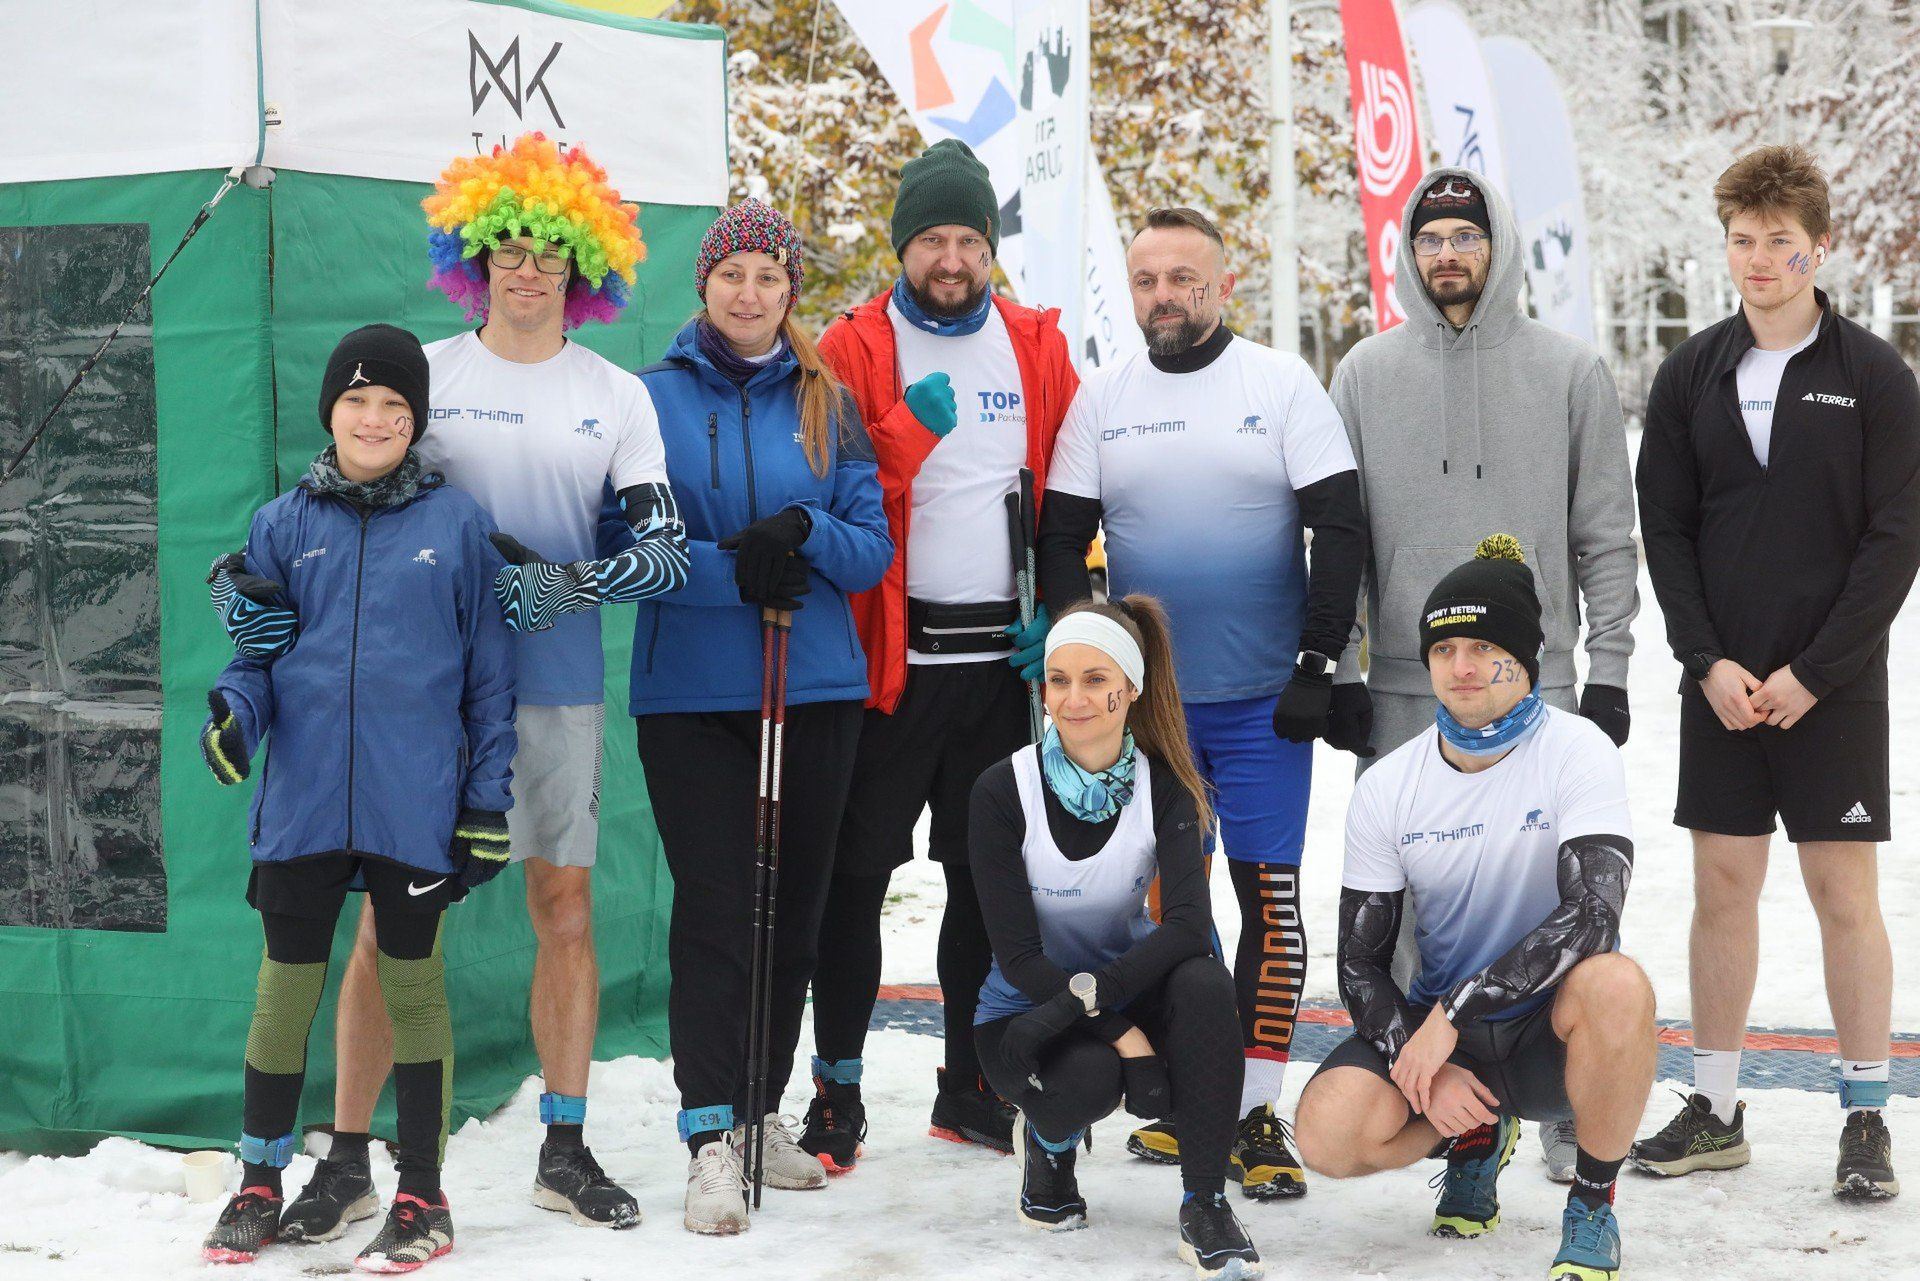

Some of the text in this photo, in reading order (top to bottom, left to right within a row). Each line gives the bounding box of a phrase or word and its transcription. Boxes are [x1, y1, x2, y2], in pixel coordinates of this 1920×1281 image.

[978, 391, 1021, 410] TOP
[1816, 393, 1857, 408] TERREX
[1450, 605, 1487, 615] WETERAN
[1107, 688, 1123, 714] 65
[1841, 815, 1872, 824] adidas
[699, 1113, 721, 1126] 163
